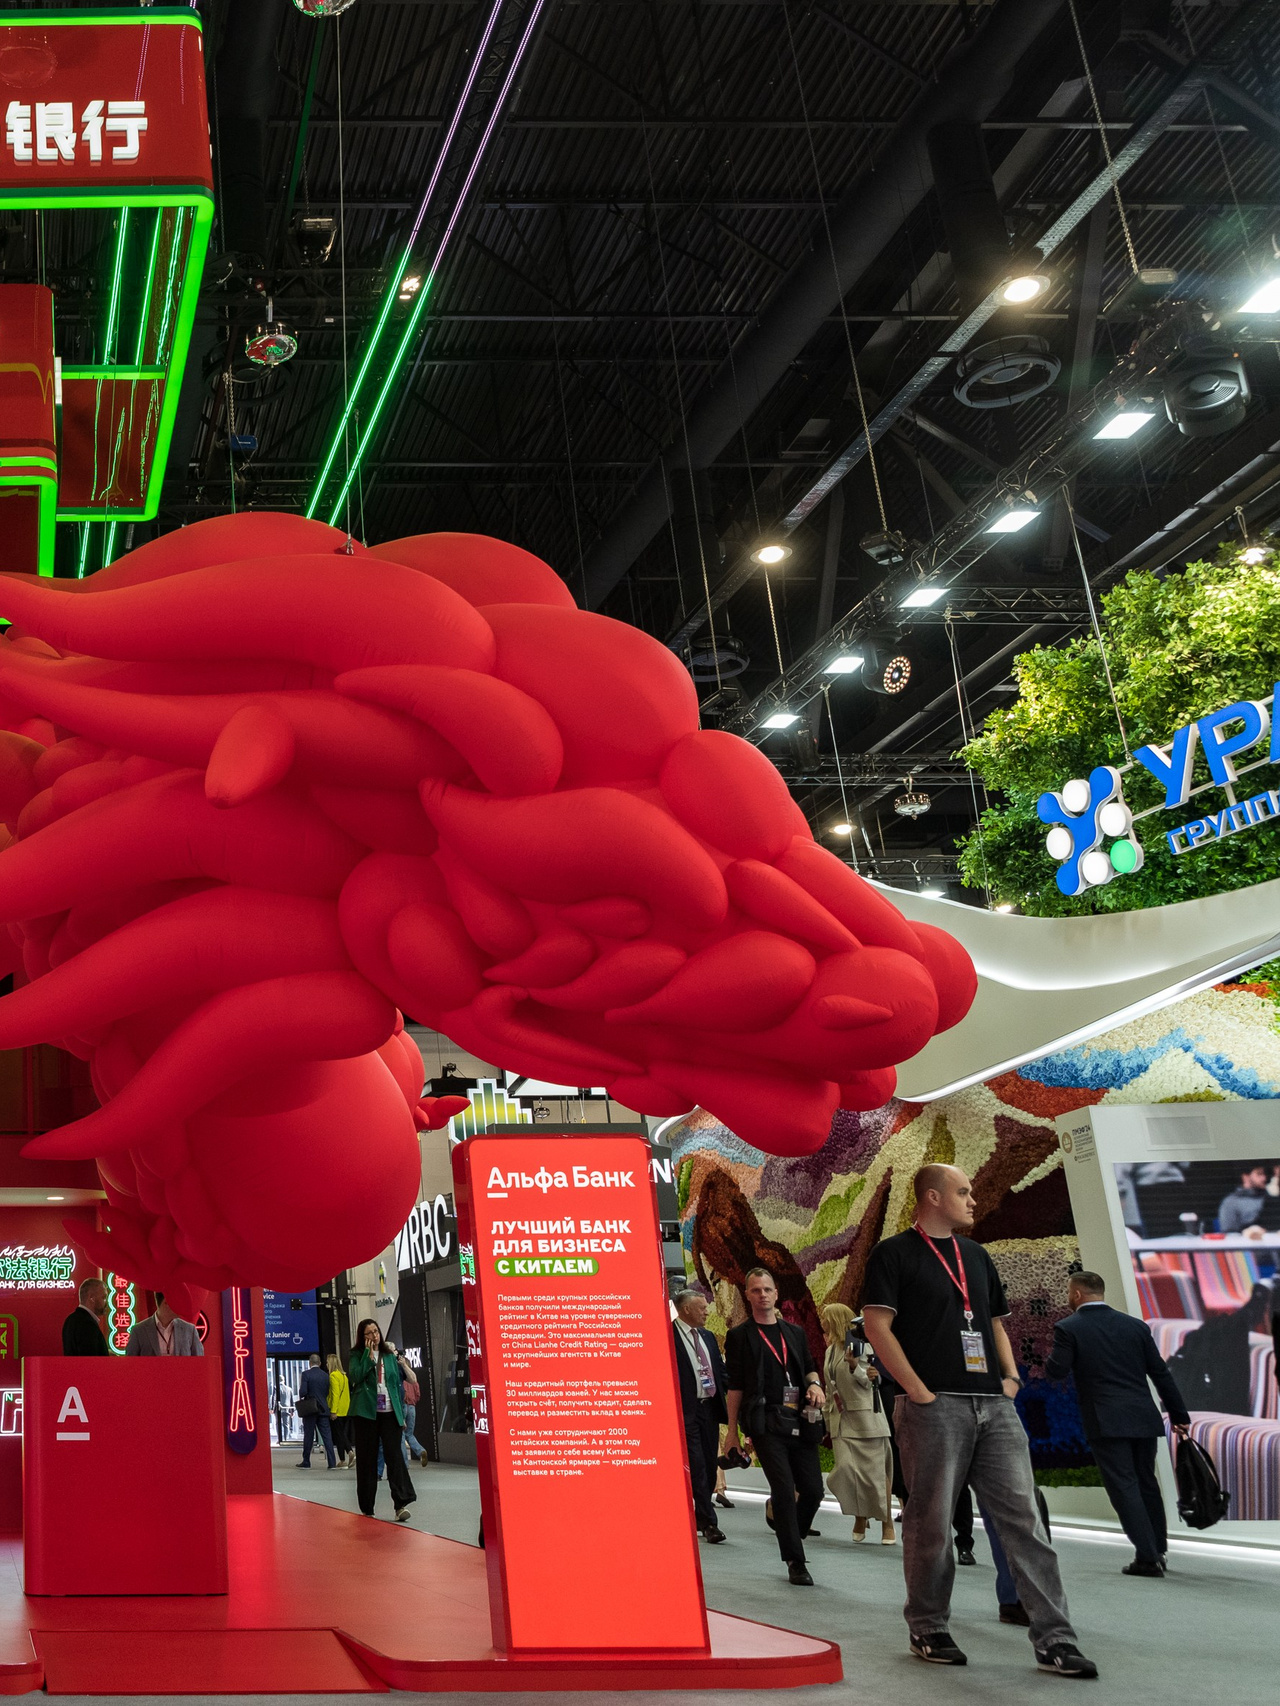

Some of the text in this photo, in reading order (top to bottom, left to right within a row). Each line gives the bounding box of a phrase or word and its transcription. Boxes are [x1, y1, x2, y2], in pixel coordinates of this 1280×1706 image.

[1166, 786, 1280, 855] ГРУПП
[487, 1166, 636, 1195] Альфа Банк
[491, 1216, 632, 1235] ЛУЧШИЙ БАНК
[492, 1238, 626, 1256] ДЛЯ БИЗНЕСА
[497, 1259, 593, 1274] С КИТАЕМ
[17, 1280, 35, 1290] ДЛЯ
[36, 1280, 75, 1289] БИЗНЕСА
[496, 1293, 532, 1302] Первыми
[588, 1293, 632, 1302] российских
[498, 1303, 524, 1311] банков
[562, 1303, 622, 1312] международный
[498, 1312, 528, 1321] рейтинг
[598, 1313, 642, 1321] суверенного
[544, 1322, 578, 1331] рейтинга
[500, 1331, 546, 1340] Федерации.
[616, 1332, 642, 1340] оценка
[512, 1341, 532, 1349] China
[584, 1341, 608, 1350] Rating
[618, 1342, 644, 1350] одного
[512, 1350, 558, 1359] крупнейших
[506, 1379, 638, 1388] Наш кредитный портфель превысил
[506, 1389, 516, 1397] 30
[57, 1386, 89, 1423] A
[538, 1399, 558, 1408] счёт,
[594, 1400, 622, 1408] кредит,
[510, 1428, 516, 1436] С
[510, 1438, 550, 1446] китайских
[624, 1439, 640, 1447] году
[522, 1458, 568, 1466] Кантонской
[612, 1457, 658, 1466] крупнейшей
